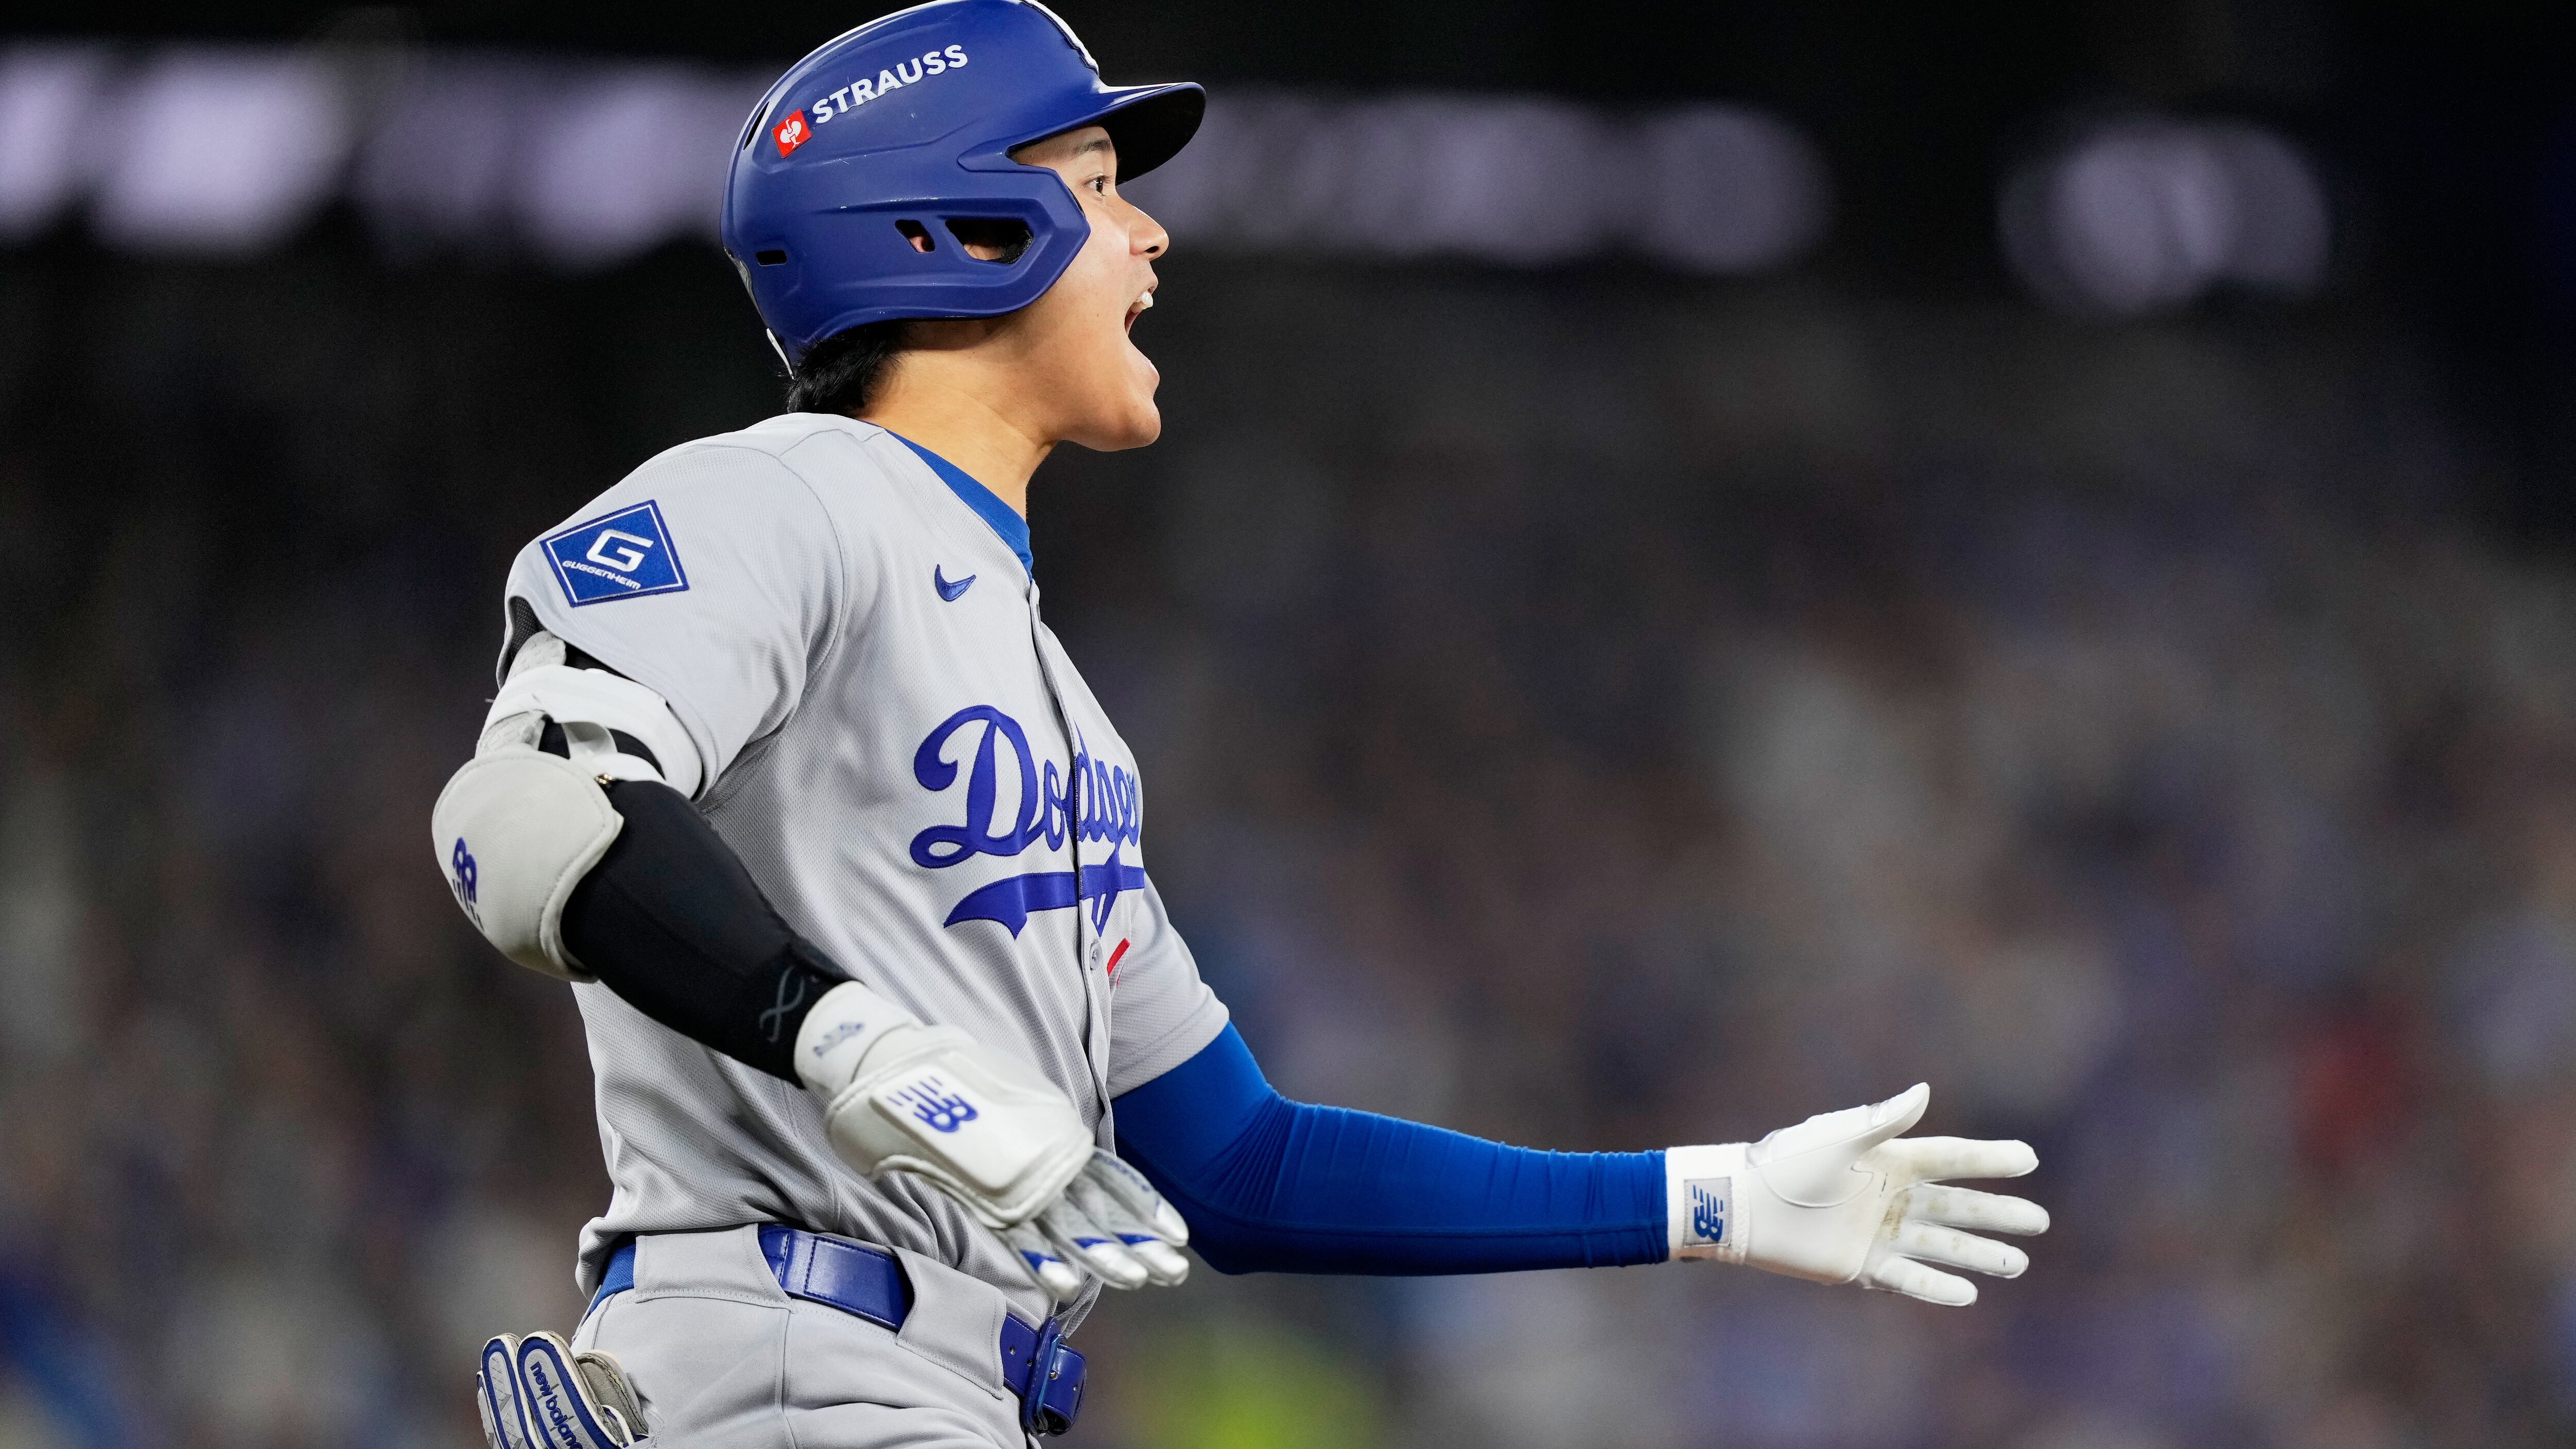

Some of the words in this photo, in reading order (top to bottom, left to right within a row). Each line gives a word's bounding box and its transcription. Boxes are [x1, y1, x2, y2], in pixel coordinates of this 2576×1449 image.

[812, 44, 969, 124] STRAUSS
[586, 529, 654, 572] G
[562, 560, 641, 591] GUGGENHEIM
[530, 1361, 553, 1396] new
